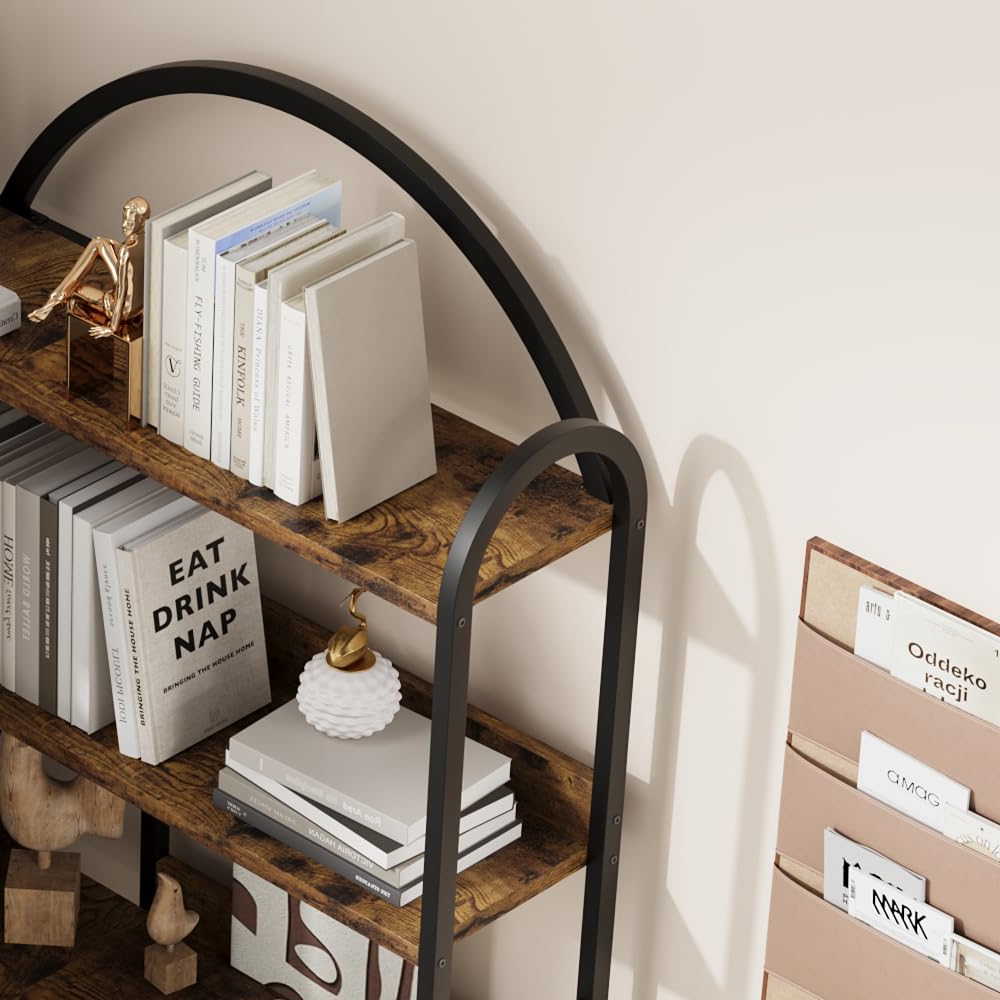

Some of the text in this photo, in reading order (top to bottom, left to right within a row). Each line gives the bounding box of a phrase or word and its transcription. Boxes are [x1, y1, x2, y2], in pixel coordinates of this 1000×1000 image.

[191, 295, 203, 413] FLY-FISHING GUIDE
[235, 344, 247, 408] KINFOLK
[167, 536, 226, 587] EAT
[151, 562, 251, 634] DRINK
[865, 600, 882, 617] arts
[124, 587, 146, 727] BRINGING THE HOUSE HOME
[173, 607, 238, 662] NAP
[162, 640, 256, 695] BRINGING THE HOUSE HOME
[907, 641, 987, 690] Oddeko
[924, 672, 969, 703] racji
[871, 888, 929, 941] MARK
